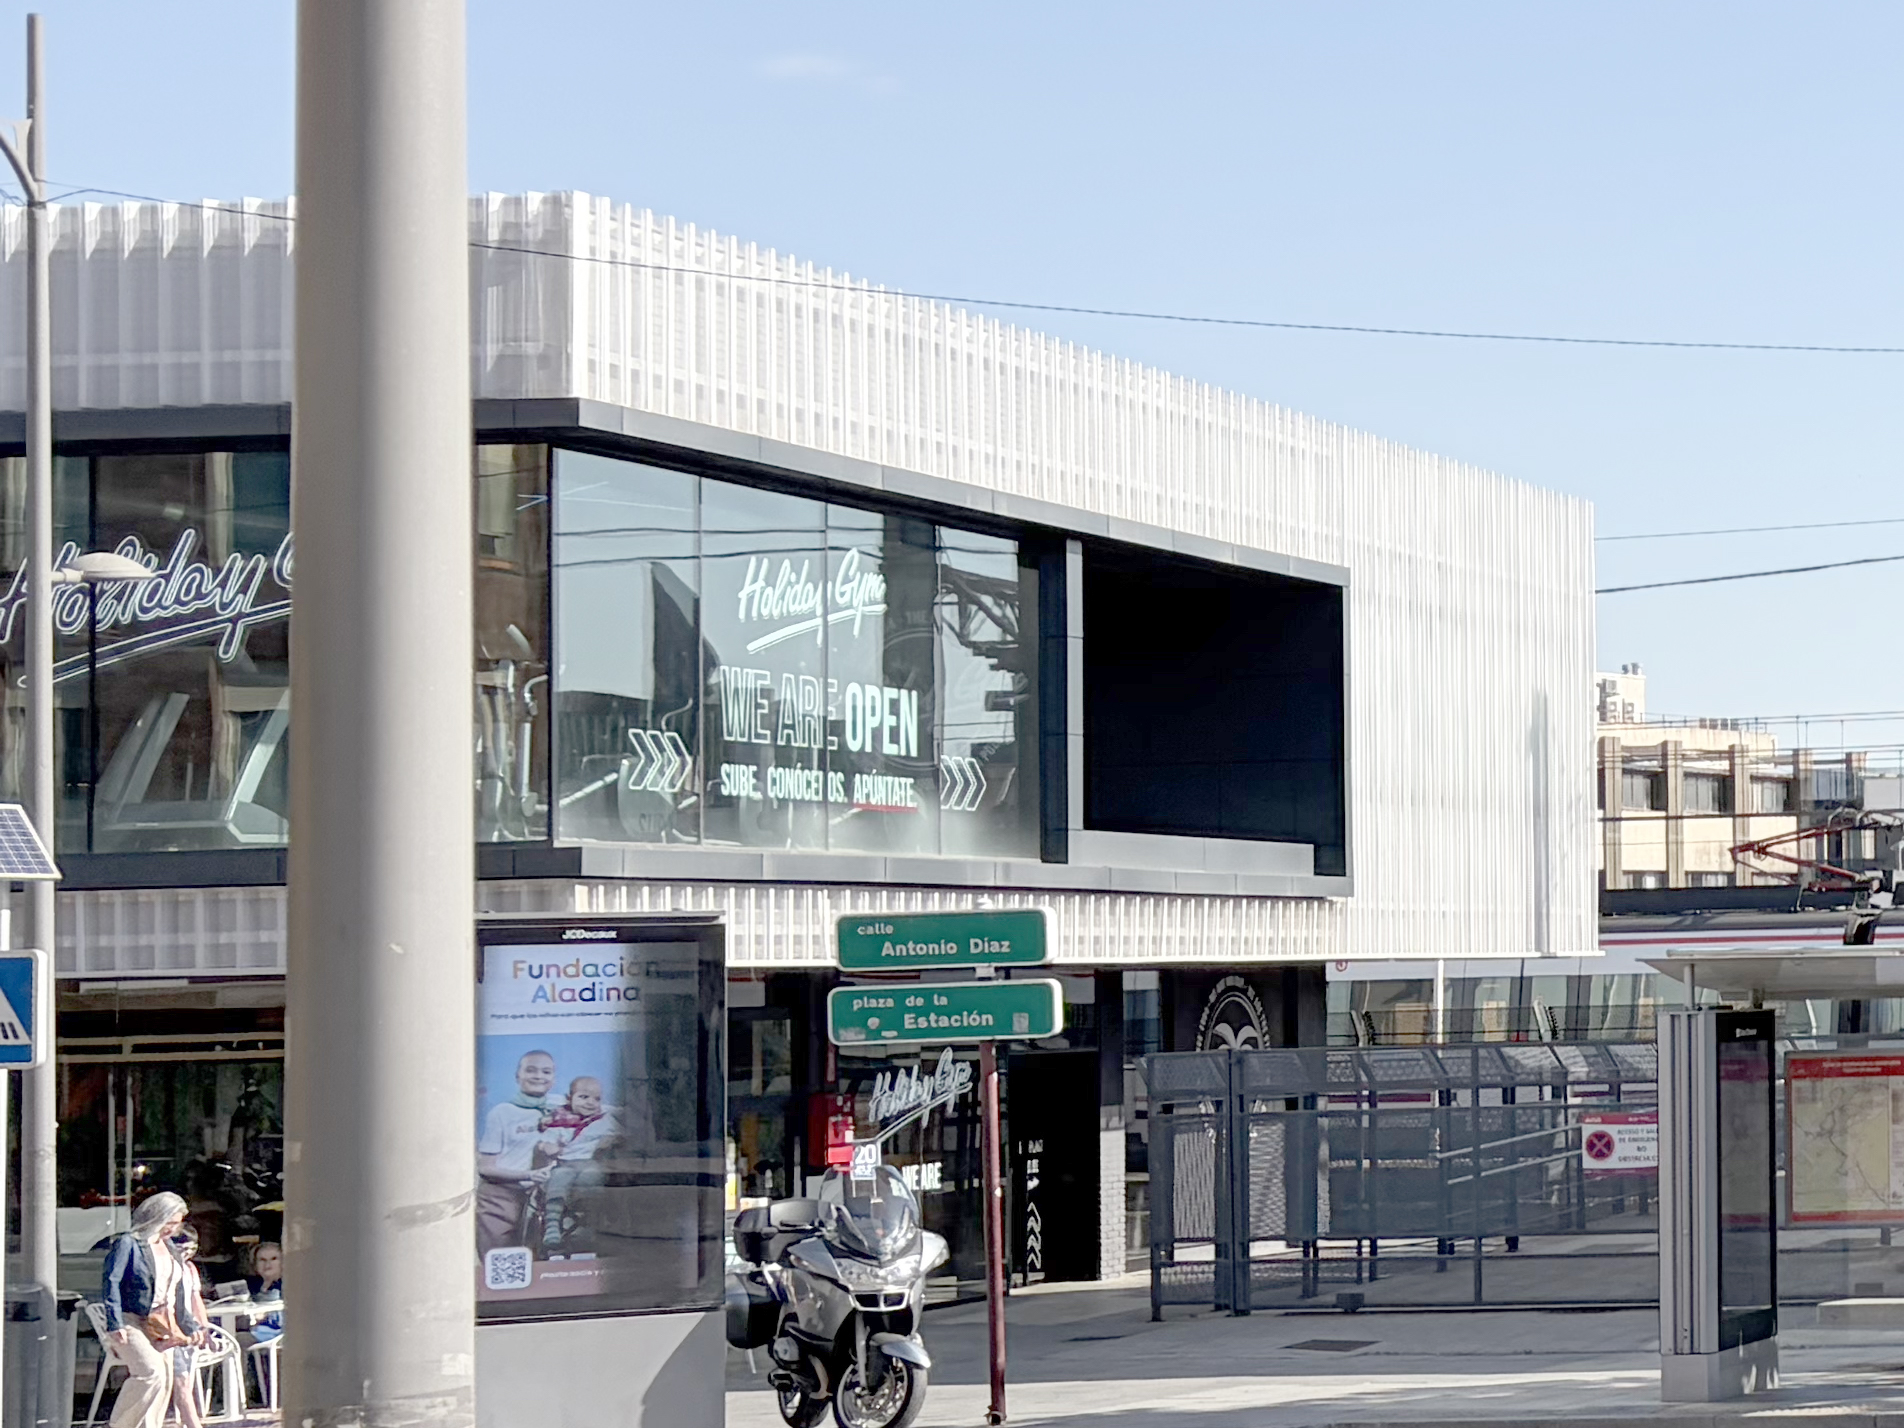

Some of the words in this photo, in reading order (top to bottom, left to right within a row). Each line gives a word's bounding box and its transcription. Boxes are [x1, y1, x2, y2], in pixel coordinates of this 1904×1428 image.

[738, 555, 832, 648] Holiday
[834, 547, 887, 639] Gym
[720, 665, 771, 745] WE
[777, 673, 838, 750] ARE
[845, 682, 918, 757] OPEN
[720, 763, 762, 798] SUBE.
[854, 769, 918, 808] APÚNTATE.
[857, 922, 894, 935] calle
[881, 939, 958, 957] Antonio
[531, 982, 641, 1003] Aladina
[853, 996, 895, 1011] plaza
[905, 994, 924, 1007] de
[933, 993, 948, 1006] la
[903, 1010, 994, 1029] Estación
[854, 1144, 876, 1164] 20
[921, 1162, 942, 1190] ARE
